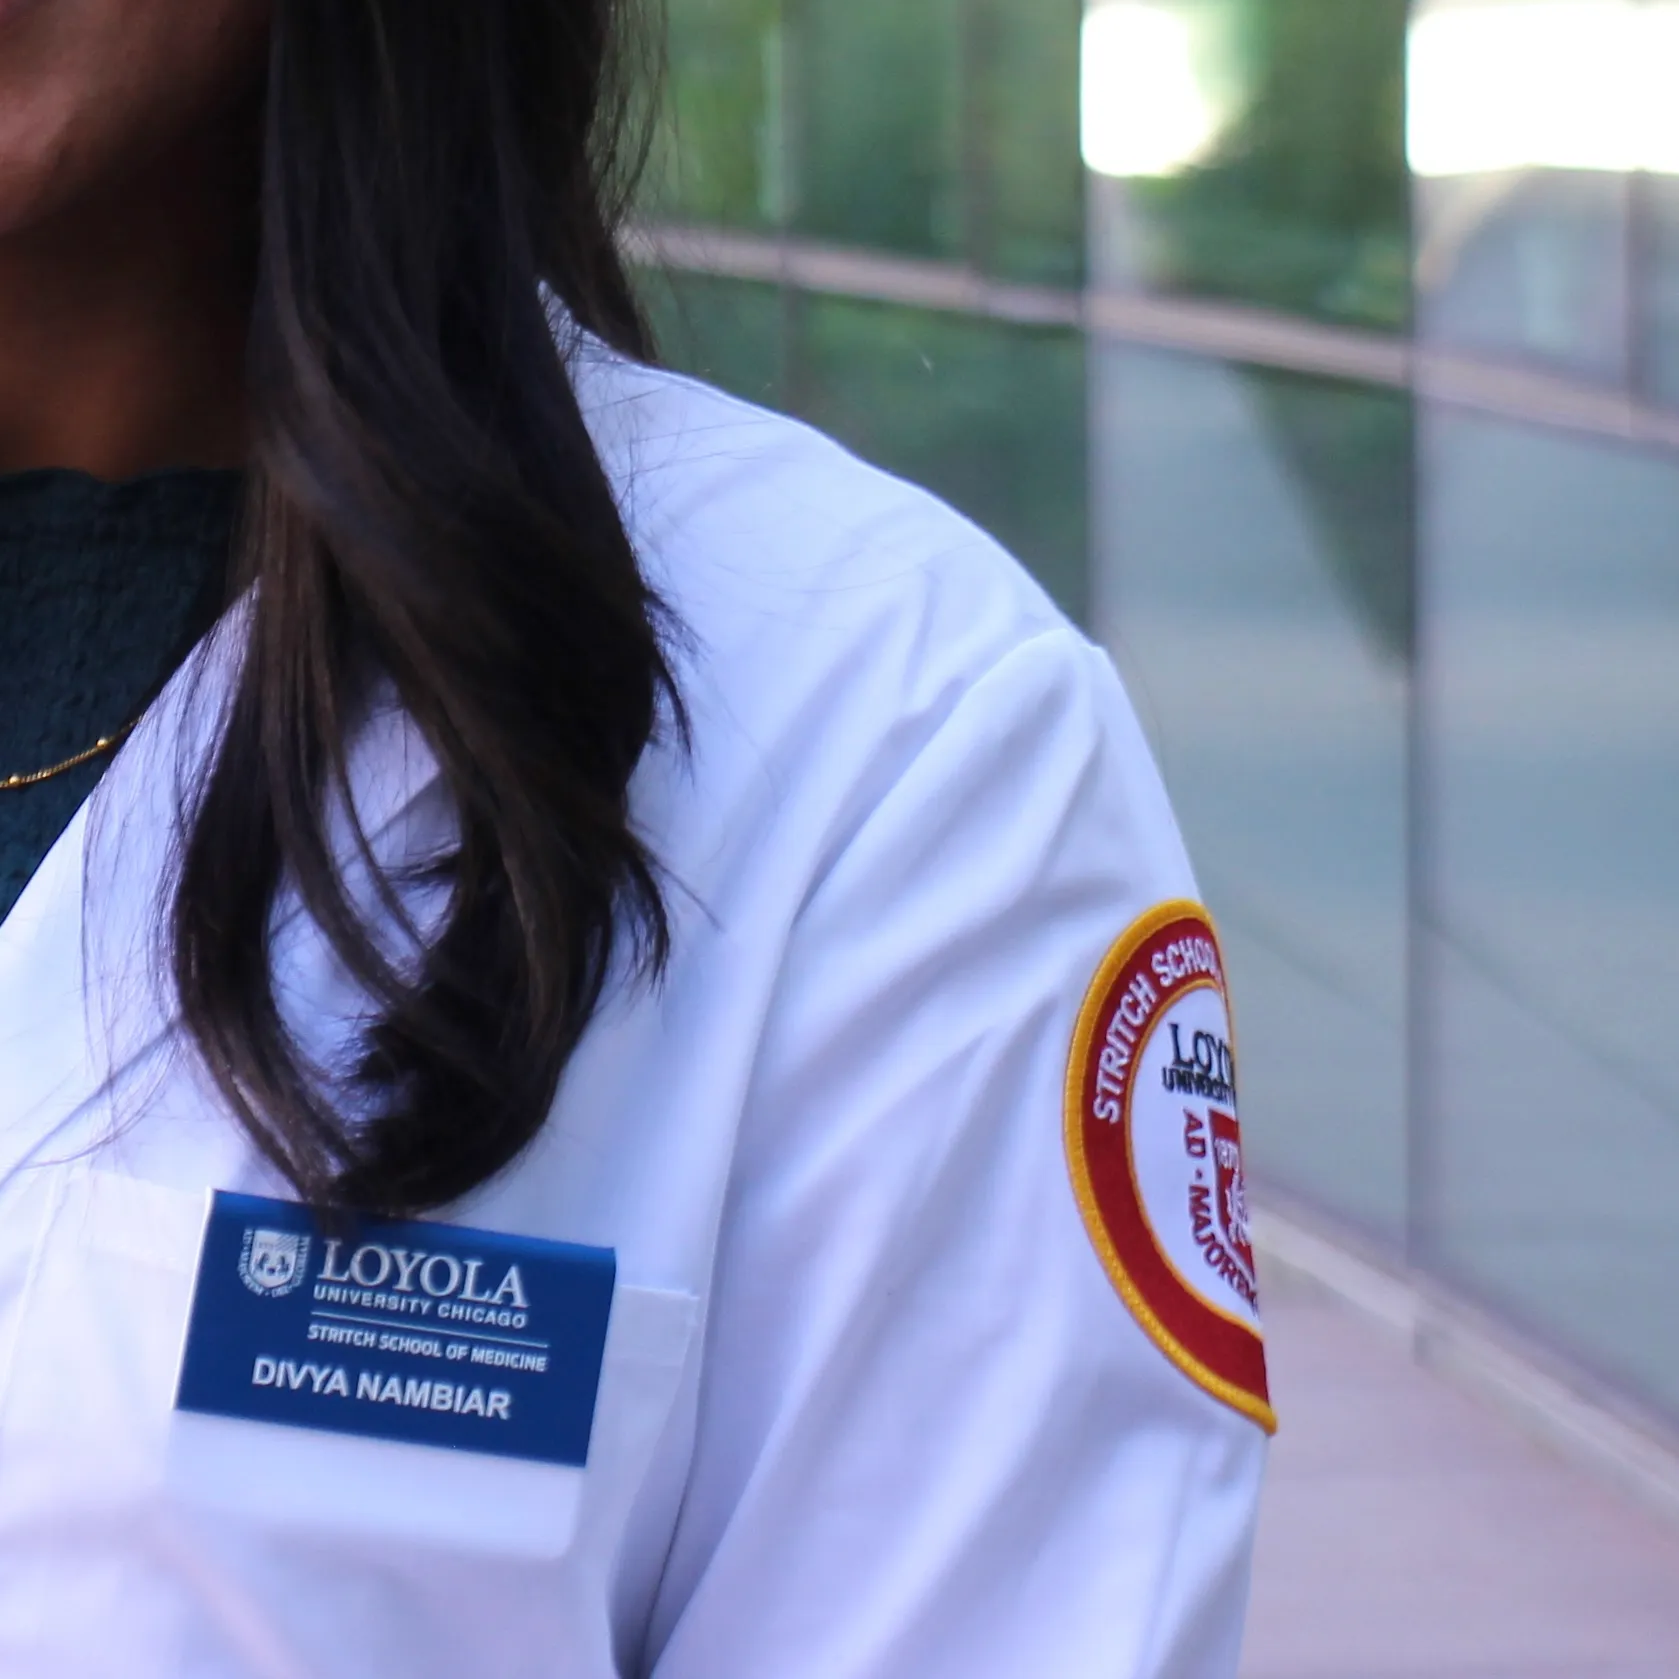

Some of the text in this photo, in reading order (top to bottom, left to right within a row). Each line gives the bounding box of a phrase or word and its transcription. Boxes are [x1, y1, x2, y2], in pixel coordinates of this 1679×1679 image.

[1093, 971, 1159, 1124] STRITCH
[1167, 1022, 1235, 1085] LOYO
[1183, 1106, 1206, 1158] AD
[317, 1238, 530, 1308] LOYOLA
[313, 1284, 527, 1329] UNIVERSITY CHICAGO
[307, 1323, 549, 1372] STRITCH SCHOOL OF MEDICINE
[251, 1355, 512, 1420] DIVYA NAMBIAR
